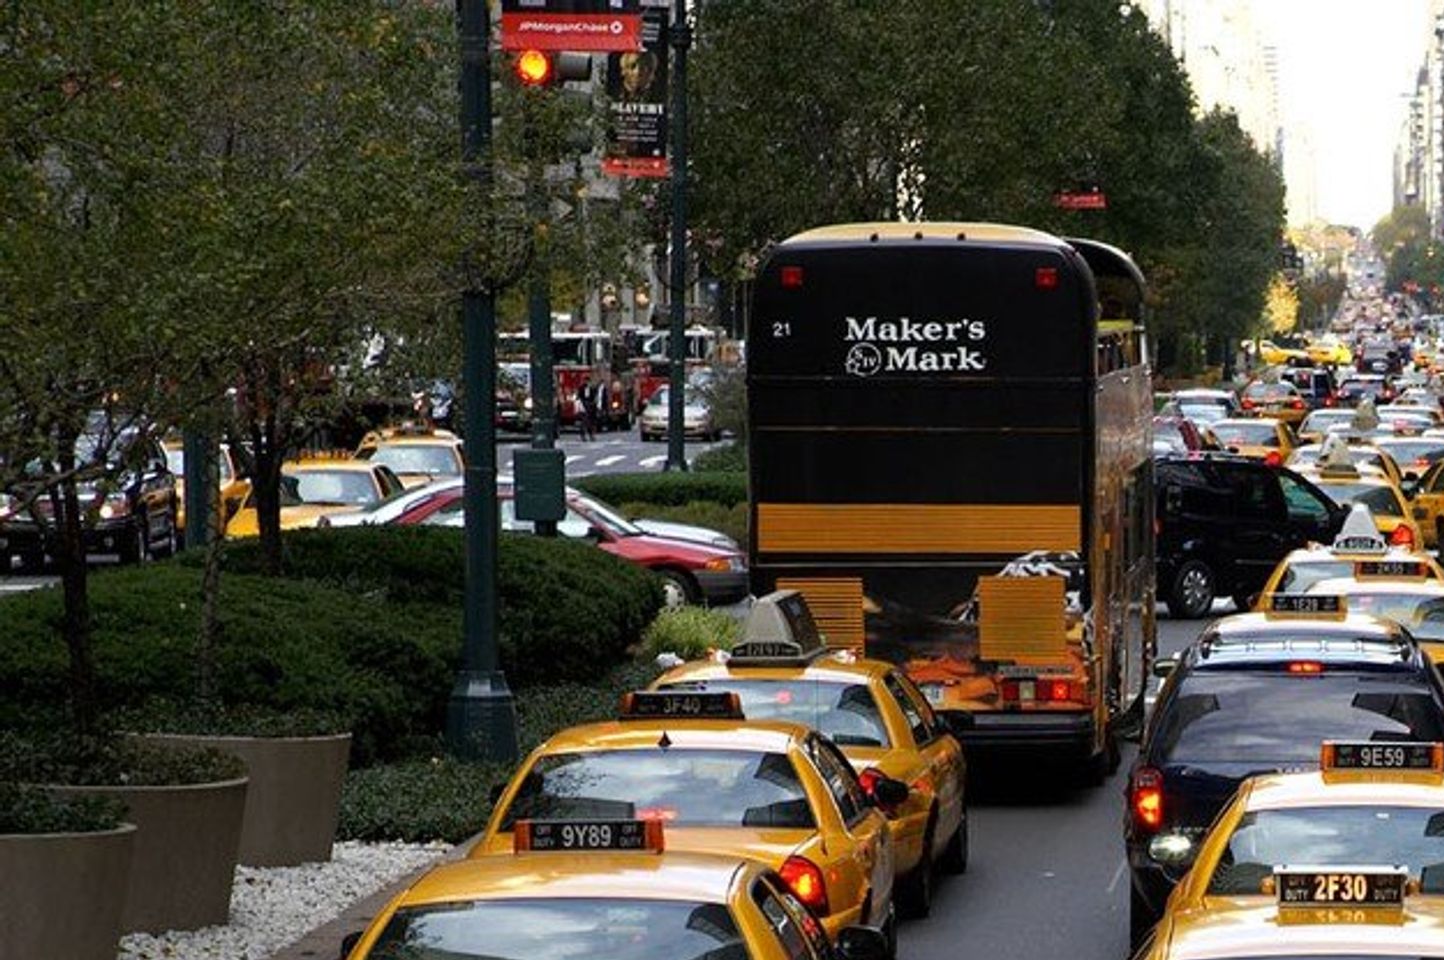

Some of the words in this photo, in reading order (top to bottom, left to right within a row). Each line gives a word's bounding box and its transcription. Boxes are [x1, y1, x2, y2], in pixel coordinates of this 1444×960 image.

[519, 21, 609, 33] JPMorganChase
[772, 321, 792, 337] 21
[843, 316, 986, 341] Maker's
[884, 346, 984, 371] Mark
[1360, 747, 1404, 766] 9E59
[562, 824, 611, 847] 9Y89
[1314, 875, 1367, 901] 2F30
